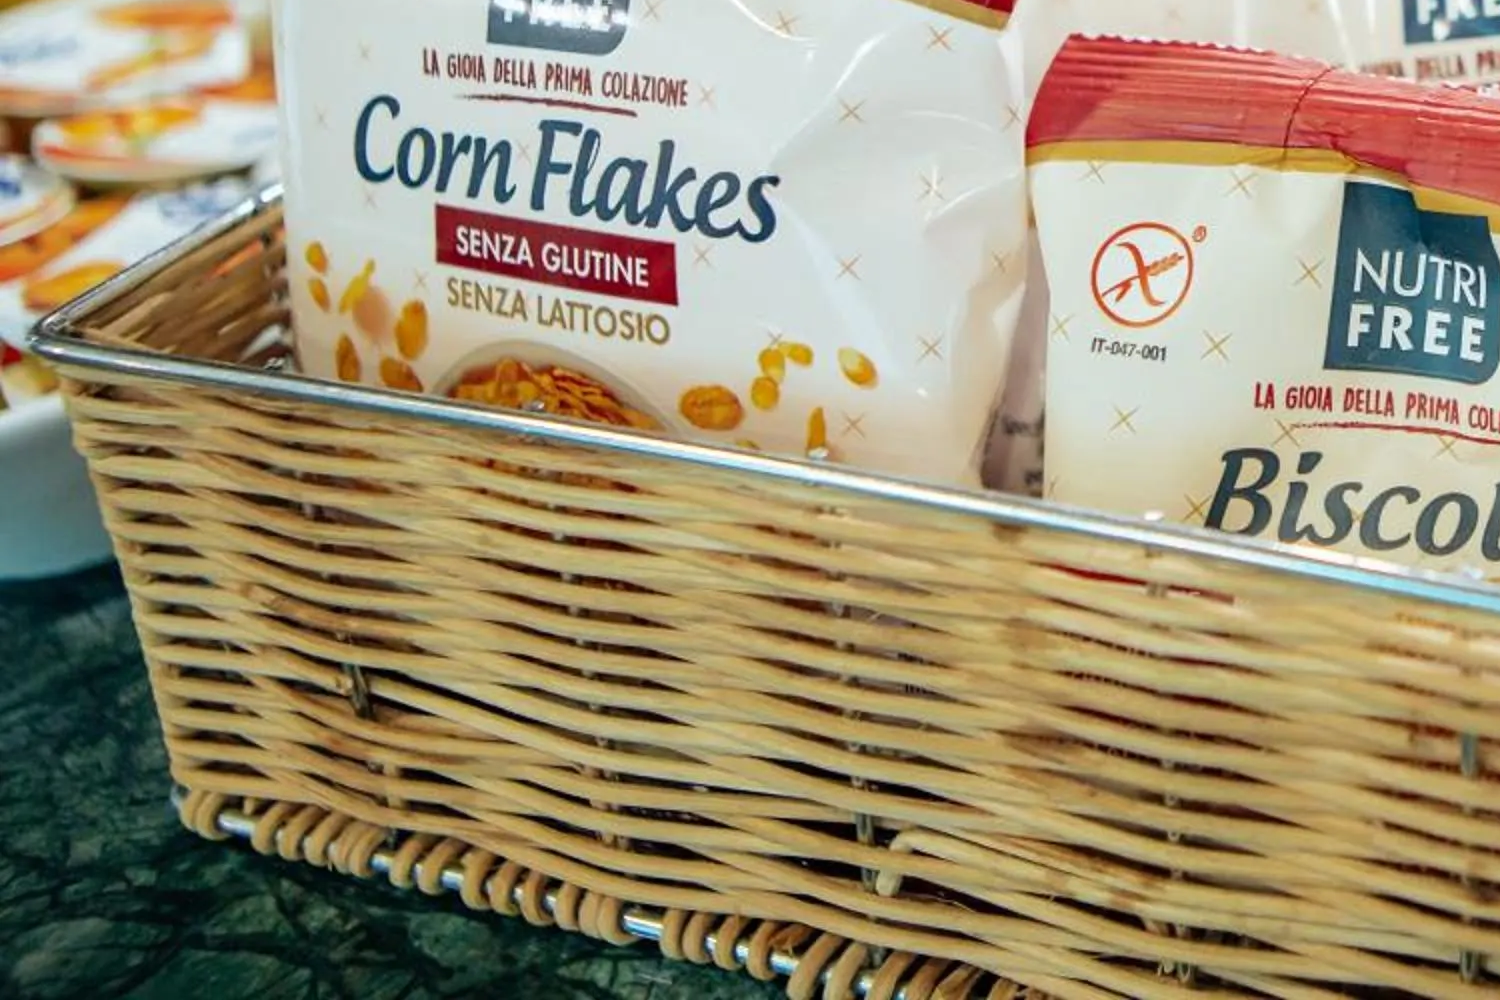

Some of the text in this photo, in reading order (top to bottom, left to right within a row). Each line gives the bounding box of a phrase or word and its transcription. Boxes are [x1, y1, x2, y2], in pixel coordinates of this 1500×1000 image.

[422, 47, 688, 107] LA GIOIA DELLA PRIMA COLAZIONE
[354, 94, 780, 243] Corn Flakes
[456, 225, 649, 288] SENZA GLUTINE
[1354, 247, 1487, 308] NUTRI
[447, 276, 671, 346] SENZA LATTOSIO
[1346, 303, 1486, 363] FREE
[1091, 337, 1167, 362] IT-047-001
[1254, 381, 1275, 409] LA
[1285, 385, 1333, 412] GIOIA
[1343, 387, 1395, 417] DELLA
[1405, 393, 1460, 426] PRIMA
